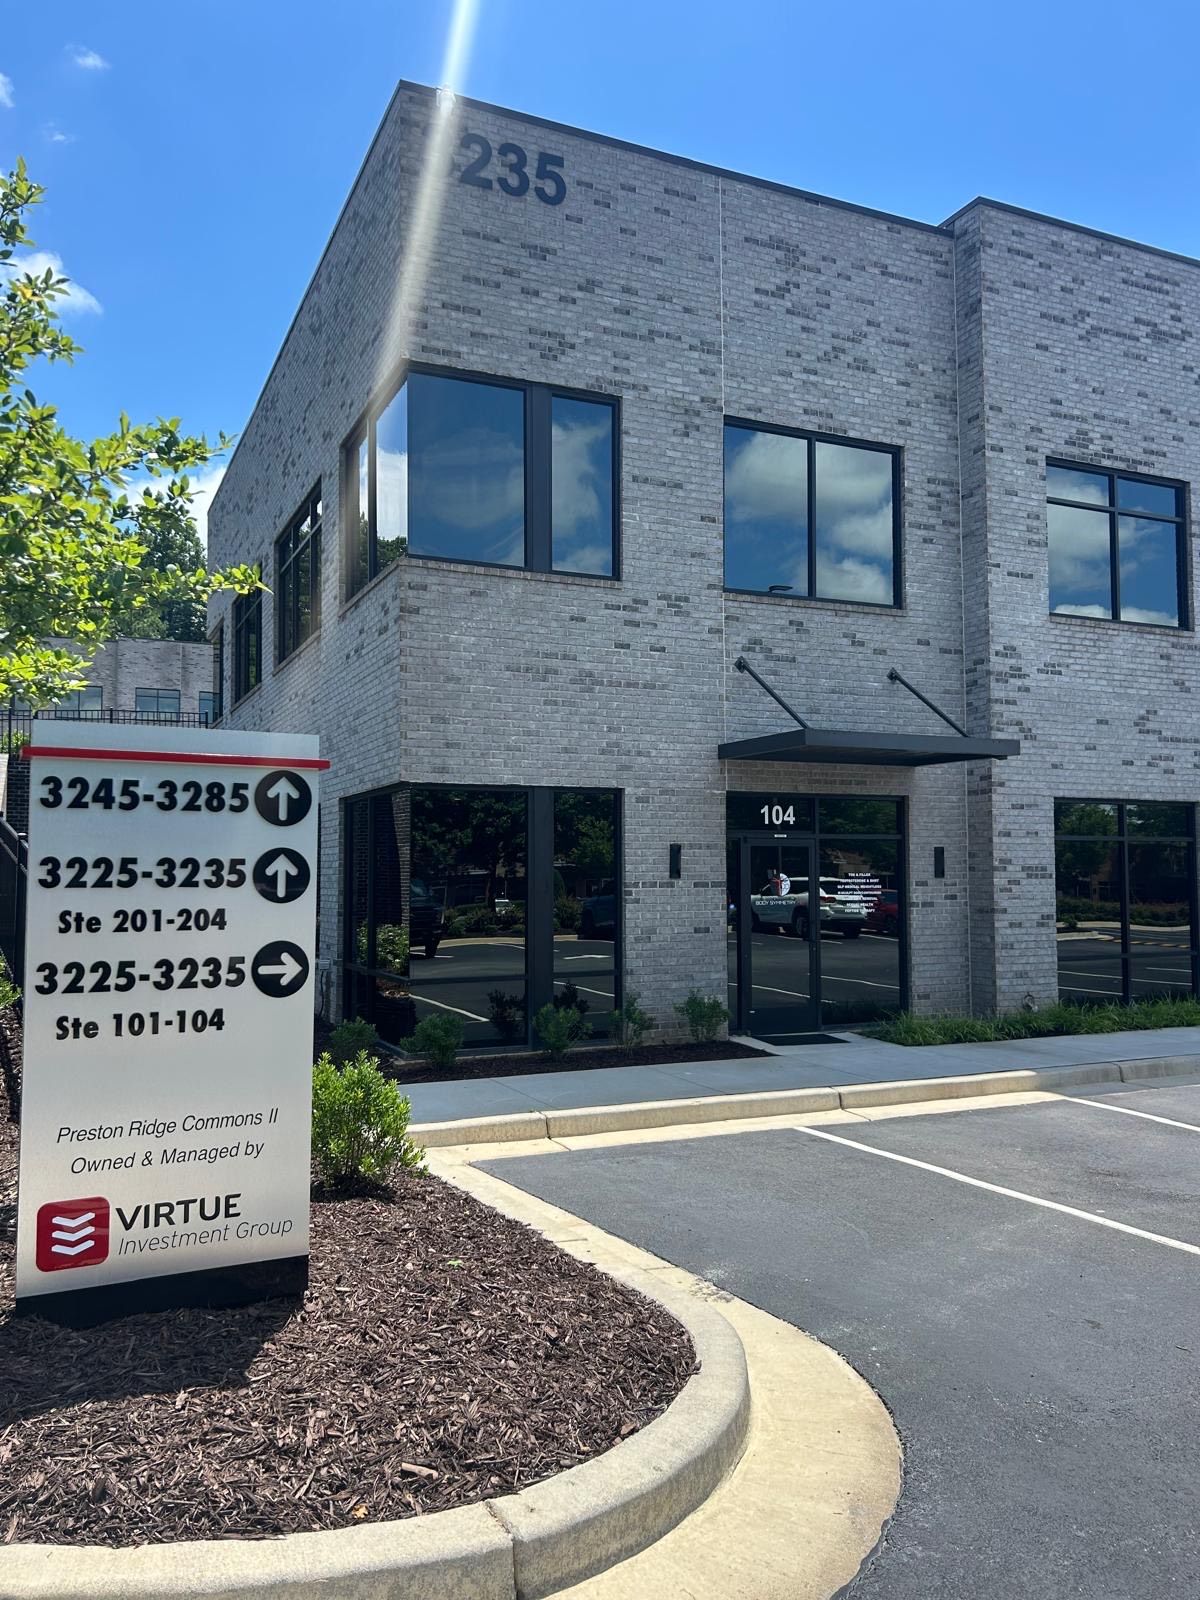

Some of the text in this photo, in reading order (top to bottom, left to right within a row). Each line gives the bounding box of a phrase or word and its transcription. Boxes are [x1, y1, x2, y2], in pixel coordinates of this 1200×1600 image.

[424, 120, 567, 206] 235
[39, 775, 250, 813] 3245-3285
[760, 804, 796, 825] 104
[37, 856, 247, 889] 3225-3235
[58, 908, 227, 934] Ste 201-204
[34, 956, 246, 995] 3225-3235
[55, 1008, 225, 1040] Ste 101-104
[56, 1108, 279, 1143] Preston Ridge Commons II
[70, 1140, 265, 1174] Owned & Managed by
[115, 1193, 242, 1232] VIRTUE
[118, 1218, 293, 1255] Investment Group
